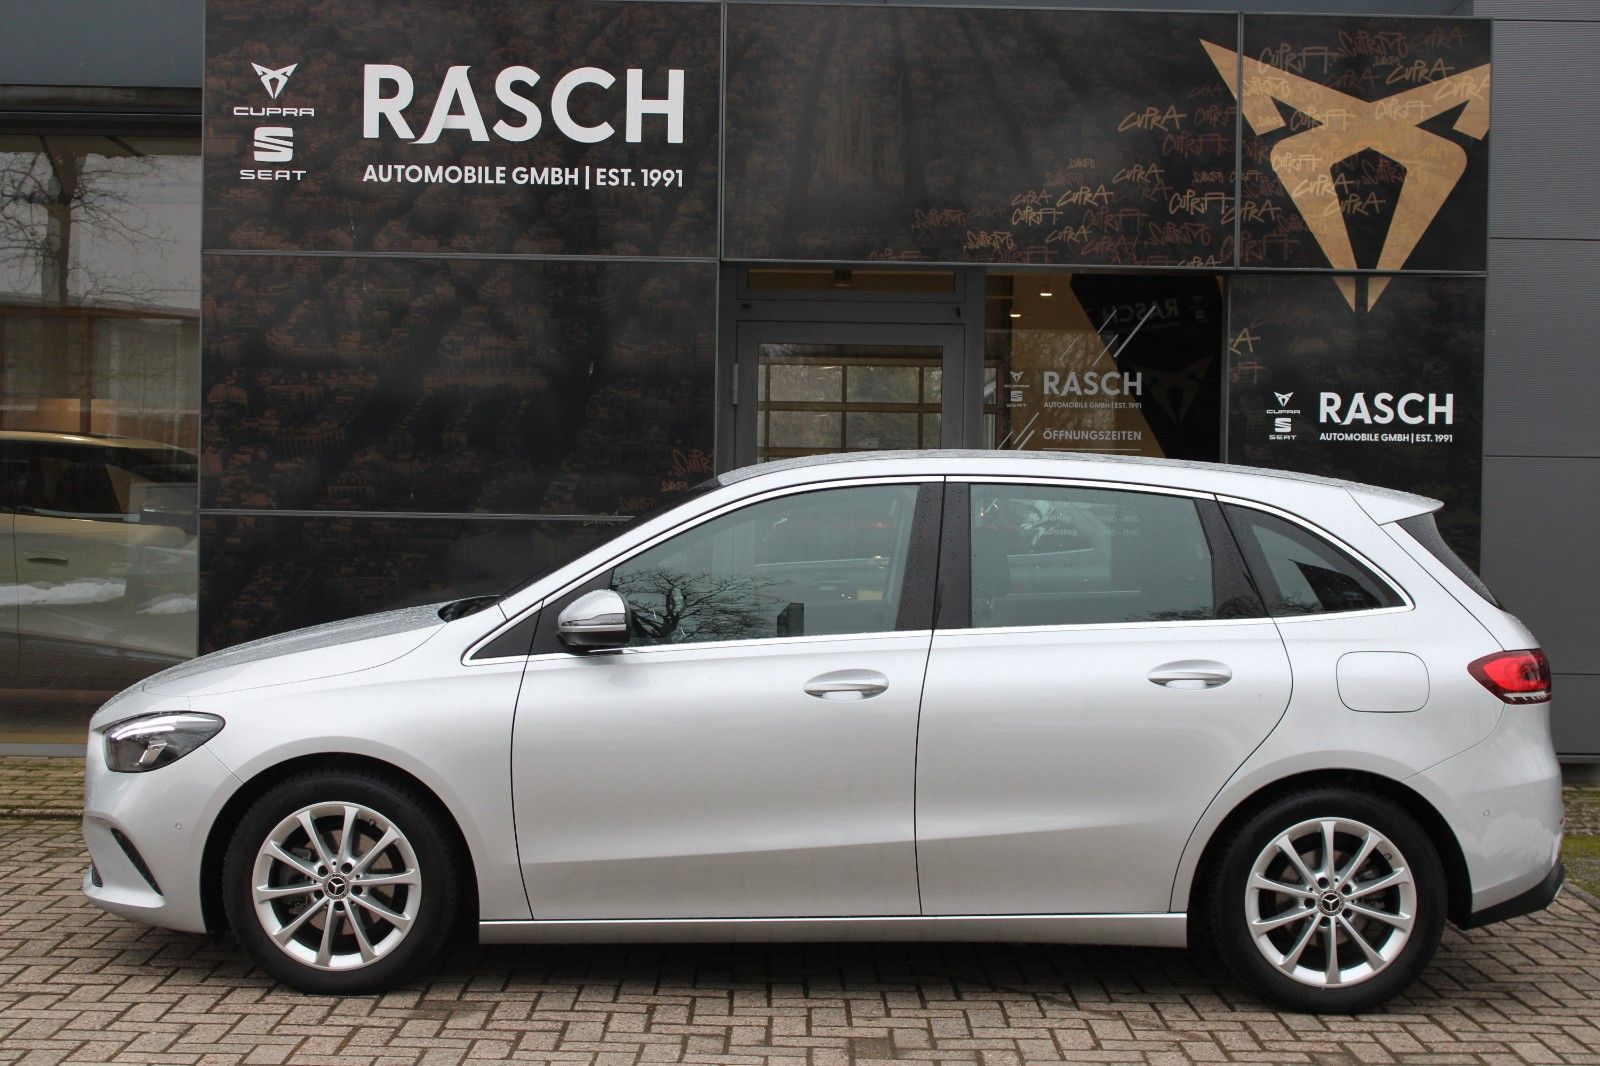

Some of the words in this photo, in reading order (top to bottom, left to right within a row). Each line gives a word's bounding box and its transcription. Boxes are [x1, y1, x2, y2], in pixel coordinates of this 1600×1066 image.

[233, 106, 315, 117] CUPRA
[363, 63, 685, 145] RASCH
[1117, 104, 1187, 132] CUPRA
[239, 169, 307, 181] SEAT
[362, 163, 507, 185] AUTOMOBILE
[512, 166, 579, 186] GMBH
[596, 168, 636, 188] EST.
[641, 169, 684, 188] 1991
[1112, 162, 1165, 184] CUPRA
[1056, 184, 1114, 207] CUPRA
[1043, 371, 1143, 397] RASCH
[1319, 391, 1454, 426] RASCH
[1043, 428, 1142, 441] ÖFFNUNGSZEITEN
[1319, 432, 1380, 442] AUTOMOBILE
[1380, 433, 1410, 443] GMBH
[1415, 434, 1433, 443] EST.
[1434, 434, 1453, 443] 1991
